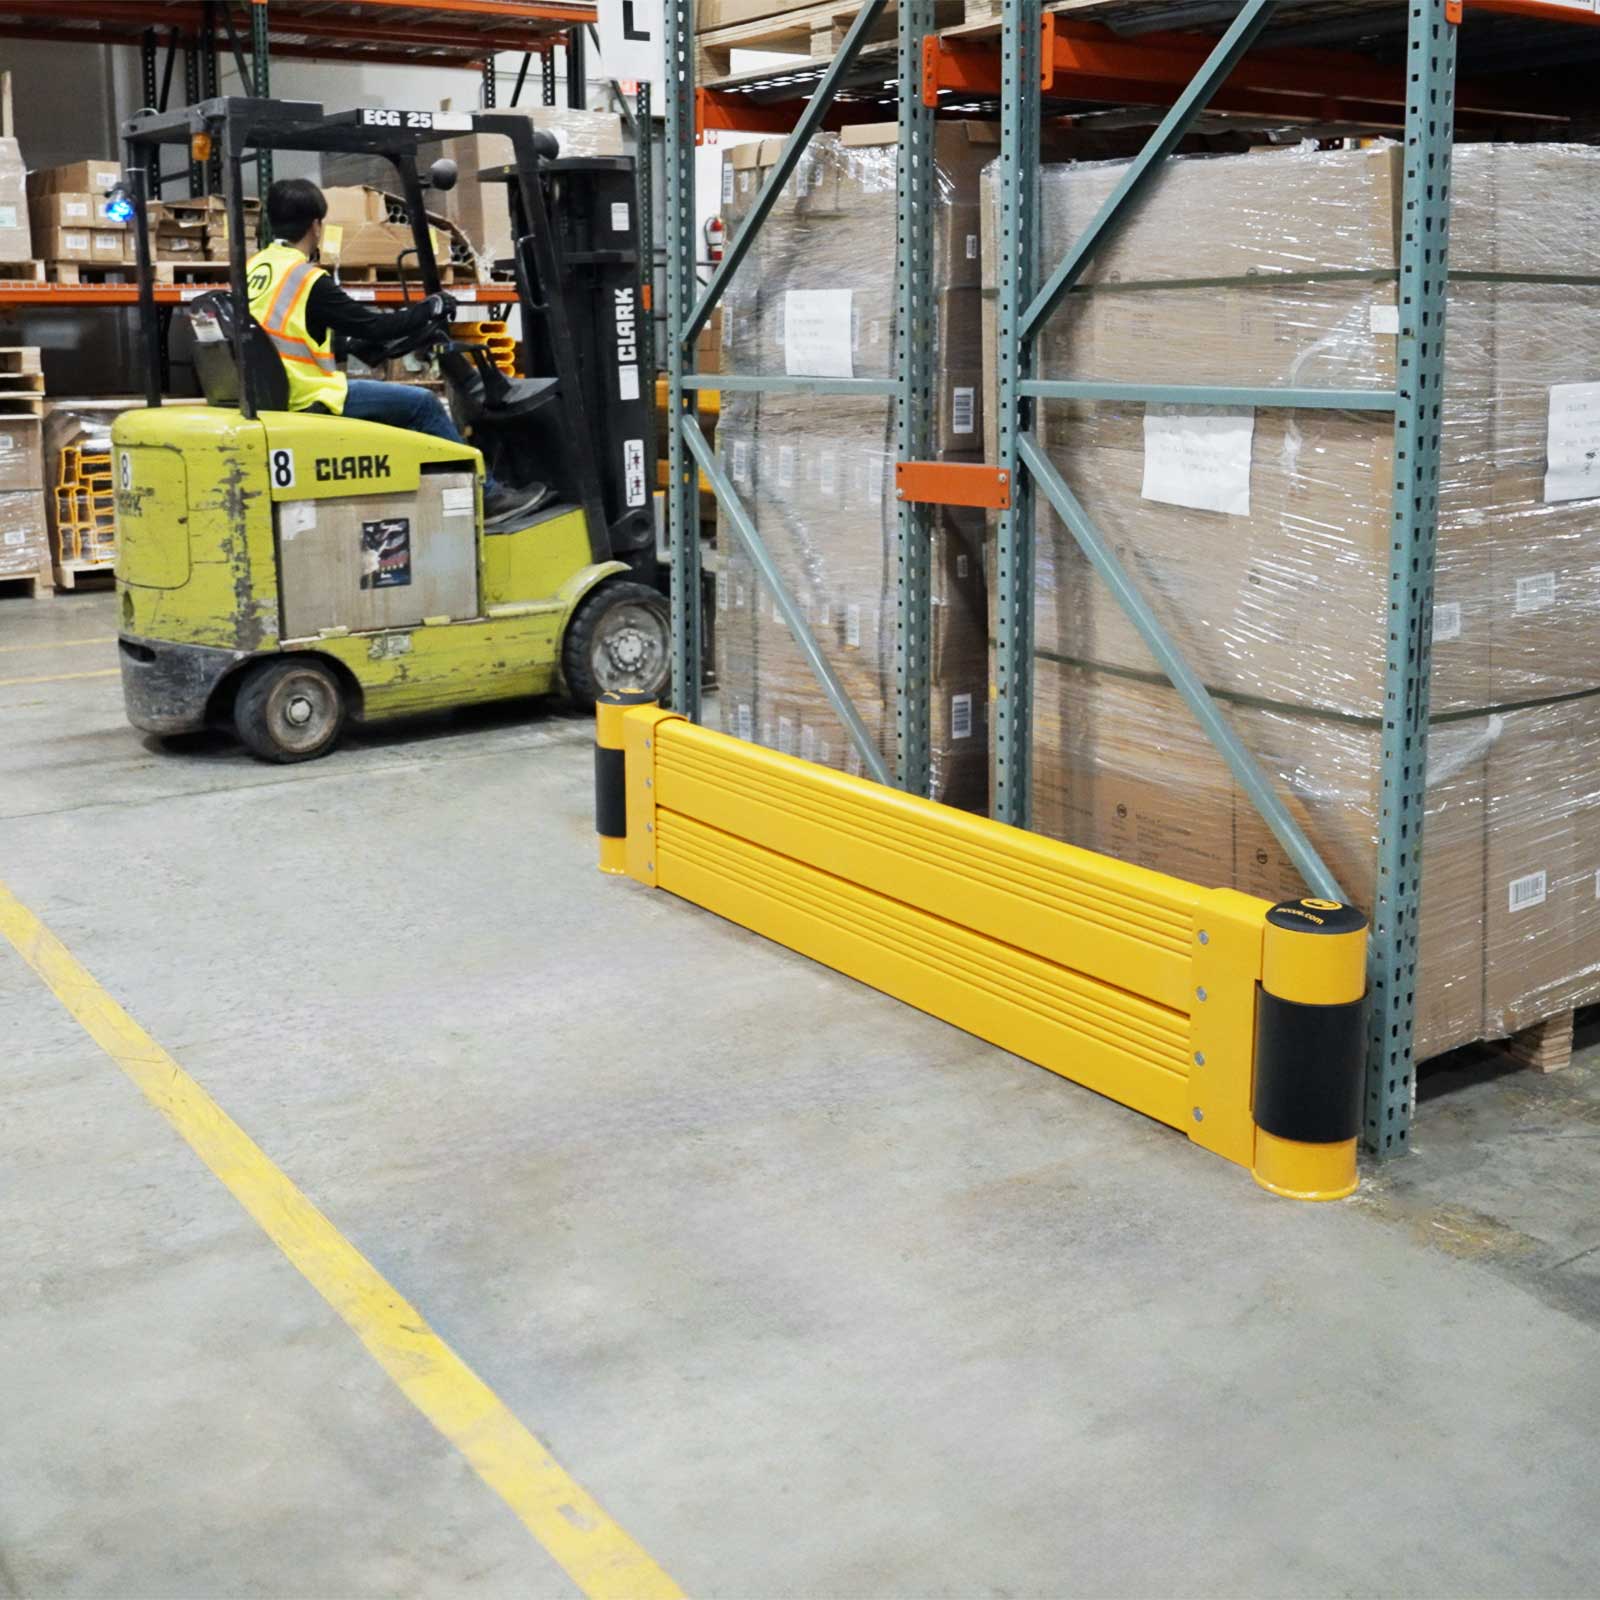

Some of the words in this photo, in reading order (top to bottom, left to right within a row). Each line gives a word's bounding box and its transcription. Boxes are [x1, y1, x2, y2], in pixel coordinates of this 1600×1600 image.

[622, 0, 651, 42] L
[363, 109, 401, 127] ECG
[406, 111, 432, 129] 25
[614, 287, 638, 362] CLARK
[273, 450, 292, 488] 8
[314, 454, 391, 481] CLARK
